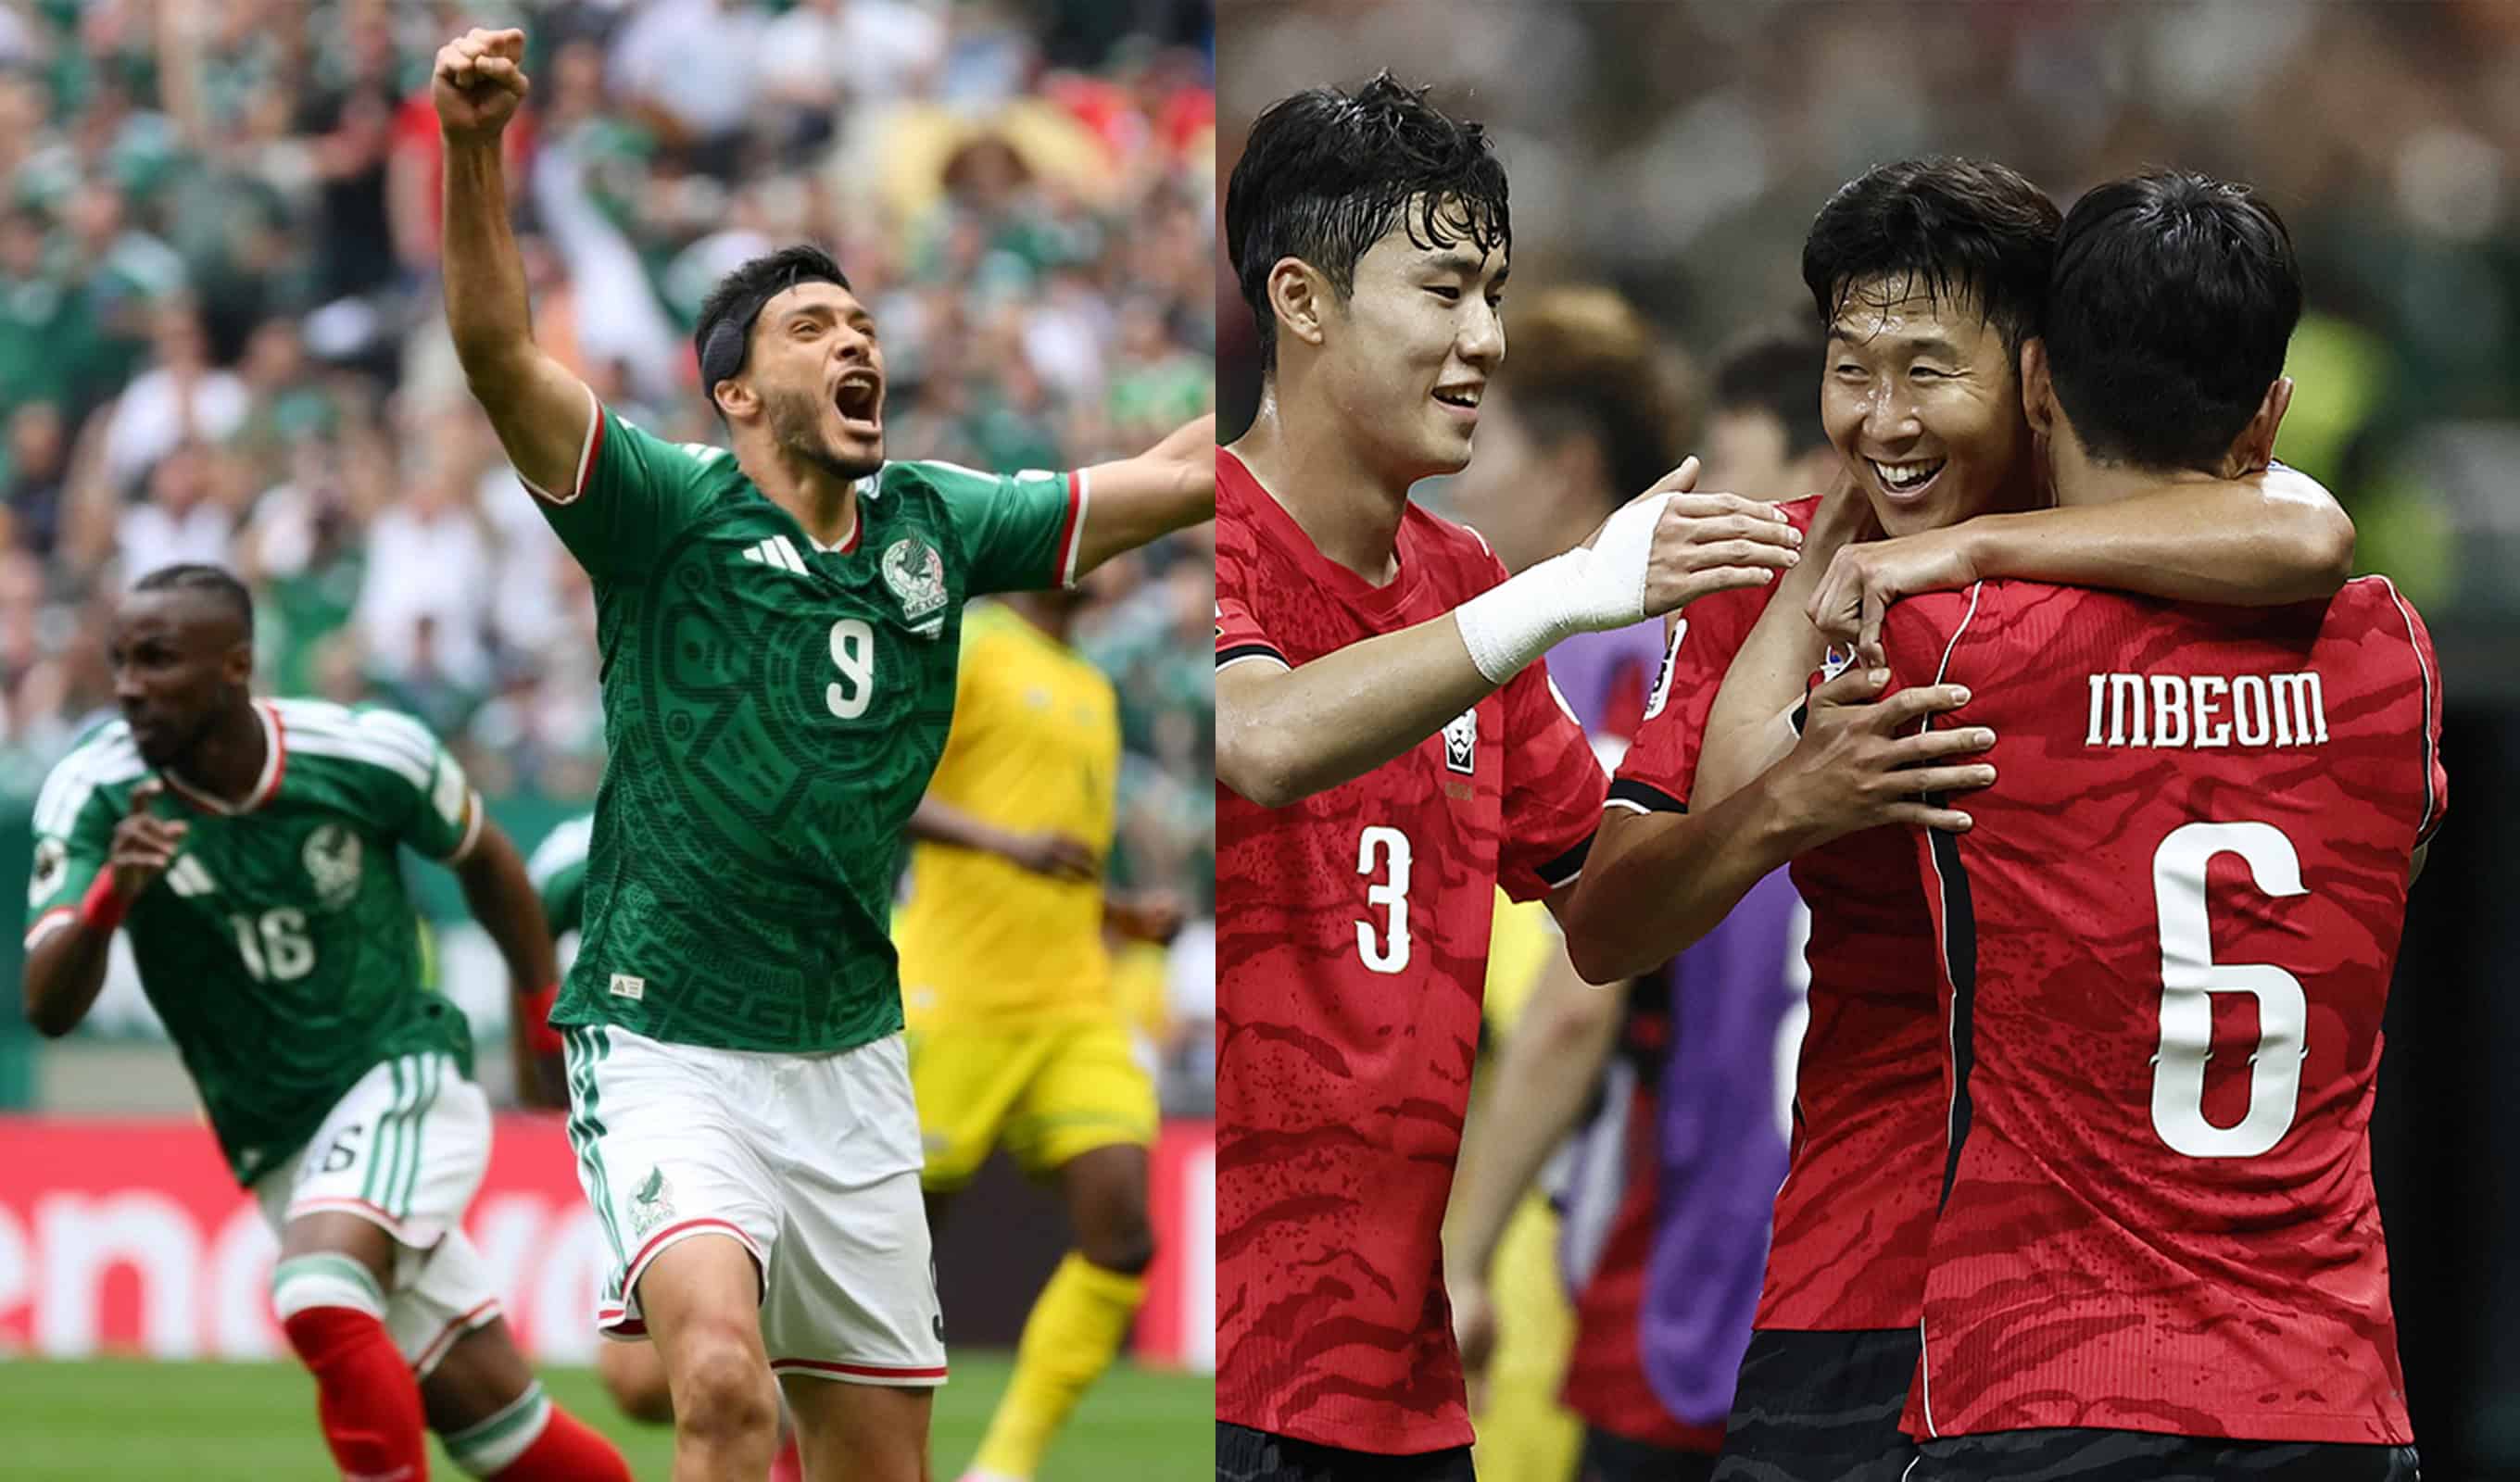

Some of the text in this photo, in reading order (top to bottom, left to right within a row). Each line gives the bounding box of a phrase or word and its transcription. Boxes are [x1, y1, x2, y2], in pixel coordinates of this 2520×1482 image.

[826, 620, 873, 719] 9
[2086, 672, 2328, 748] INBEOM
[233, 910, 315, 980] 16
[1355, 826, 1412, 973] 3
[2149, 822, 2310, 1157] 6
